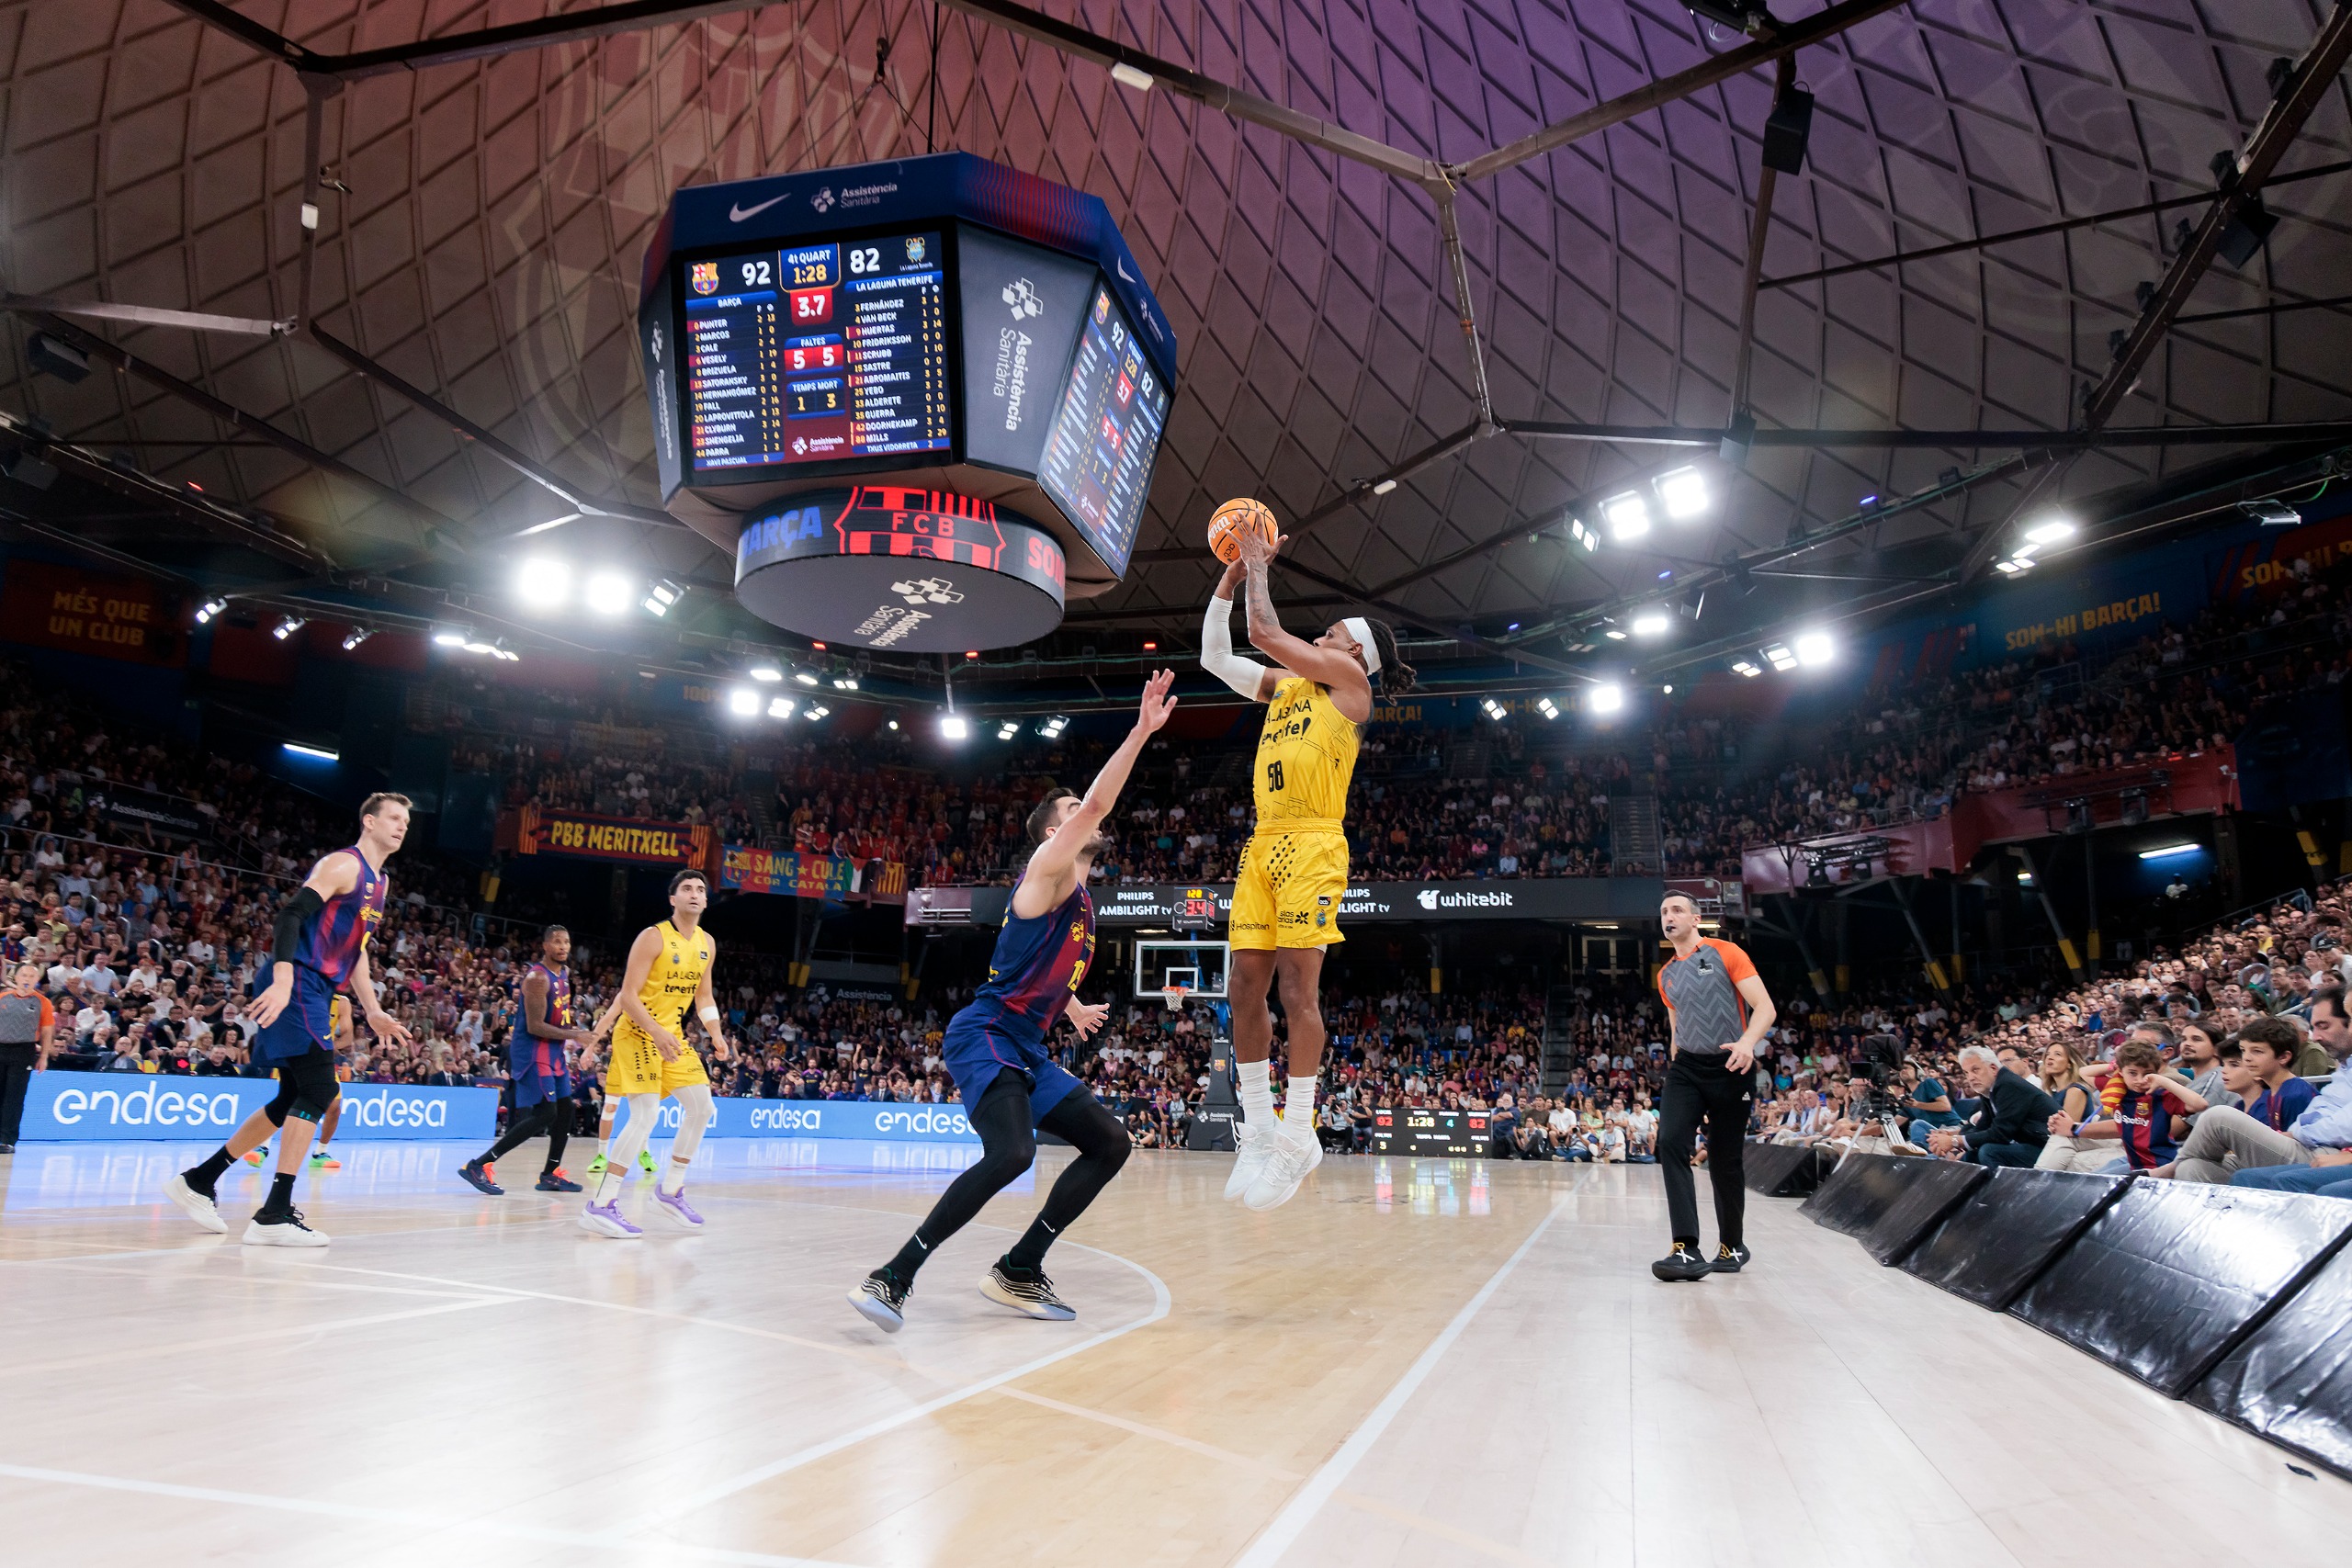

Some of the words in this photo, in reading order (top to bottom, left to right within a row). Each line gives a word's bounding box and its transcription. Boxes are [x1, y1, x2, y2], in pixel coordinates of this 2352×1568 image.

[841, 182, 897, 198] Assistència
[841, 195, 880, 208] Sanitària
[788, 254, 798, 264] 4t
[799, 250, 831, 265] QUART
[850, 248, 880, 273] 82
[742, 261, 771, 286] 92
[794, 264, 827, 284] 1:28
[856, 283, 866, 292] LA
[867, 279, 897, 291] LAGUNA
[897, 275, 933, 287] TENERIFE
[718, 297, 742, 308] BARÇA
[797, 295, 825, 317] 3.7
[860, 299, 904, 312] FERNÁNDEZ
[699, 319, 728, 330] PUNTER
[861, 314, 877, 324] VAN
[877, 312, 897, 322] BECK
[700, 331, 730, 341] MARCOS
[861, 324, 895, 336] HUERTAS
[1111, 321, 1124, 351] 92
[801, 337, 826, 347] FALTES
[862, 334, 912, 347] FRIDRIKSSON
[701, 343, 718, 353] CALE
[862, 349, 892, 360] SCRUBB
[701, 354, 727, 365] VESELY
[794, 350, 805, 370] 5
[823, 347, 834, 366] 5
[993, 327, 1016, 398] Sanitària
[702, 365, 737, 376] BRIZUELA
[863, 361, 891, 372] SASTRE
[702, 376, 748, 388] SATORANSKY
[863, 372, 910, 384] ABROMAITIS
[1006, 331, 1032, 431] Assistència
[793, 382, 817, 393] TEMPS
[817, 380, 838, 390] MORT
[864, 386, 884, 395] YEBO
[1141, 371, 1153, 399] 82
[703, 387, 756, 400] HERNANGÓMEZ
[703, 402, 720, 411] FALL
[798, 396, 806, 411] 1
[827, 393, 836, 408] 3
[865, 396, 902, 407] ALDERETE
[704, 410, 755, 423] LAPROVITTOLA
[865, 409, 896, 419] GUERRA
[704, 423, 736, 434] CLYBURN
[865, 419, 918, 431] DOORNEKAMP
[705, 434, 744, 446] SHENGELIA
[866, 433, 889, 442] MILLS
[1102, 422, 1110, 437] 5
[1111, 434, 1118, 449] 5
[706, 447, 730, 457] PARRA
[884, 442, 918, 451] VIDORRETA
[721, 457, 747, 466] PASCUAL
[1093, 460, 1098, 474] 1
[1102, 471, 1108, 484] 3
[53, 587, 98, 614] MÉS
[104, 599, 150, 622] QUE
[854, 605, 905, 635] Sanitària
[2005, 615, 2077, 651] SOM-HI
[2082, 592, 2161, 631] BARÇA!
[49, 616, 83, 637] UN
[88, 622, 144, 645] CLUB
[869, 610, 932, 646] Assistència
[1373, 705, 1422, 725] ARÇA!
[552, 821, 585, 848] PBB
[588, 825, 679, 857] MERITXELL
[754, 854, 794, 876] SANG
[754, 875, 780, 885] COR
[1117, 892, 1154, 900] PHILIPS
[1341, 889, 1370, 898] ILIPS
[1441, 892, 1513, 907] whitebit
[1099, 905, 1160, 916] AMBILIGHT
[1161, 906, 1172, 915] tv
[1338, 902, 1376, 913] ILIGHT
[1378, 904, 1390, 913] tv
[1236, 922, 1270, 931] Hospiten
[667, 971, 678, 979] LA
[680, 971, 702, 980] LAGUN
[665, 984, 697, 994] tenerif
[836, 988, 892, 1001] Assistència
[53, 1080, 239, 1126] endesa
[341, 1089, 446, 1127] ndesa
[750, 1103, 821, 1130] endesa
[1376, 1116, 1393, 1126] 92
[1407, 1117, 1435, 1127] 1:28
[1446, 1119, 1454, 1127] 4
[1469, 1118, 1486, 1129] 82
